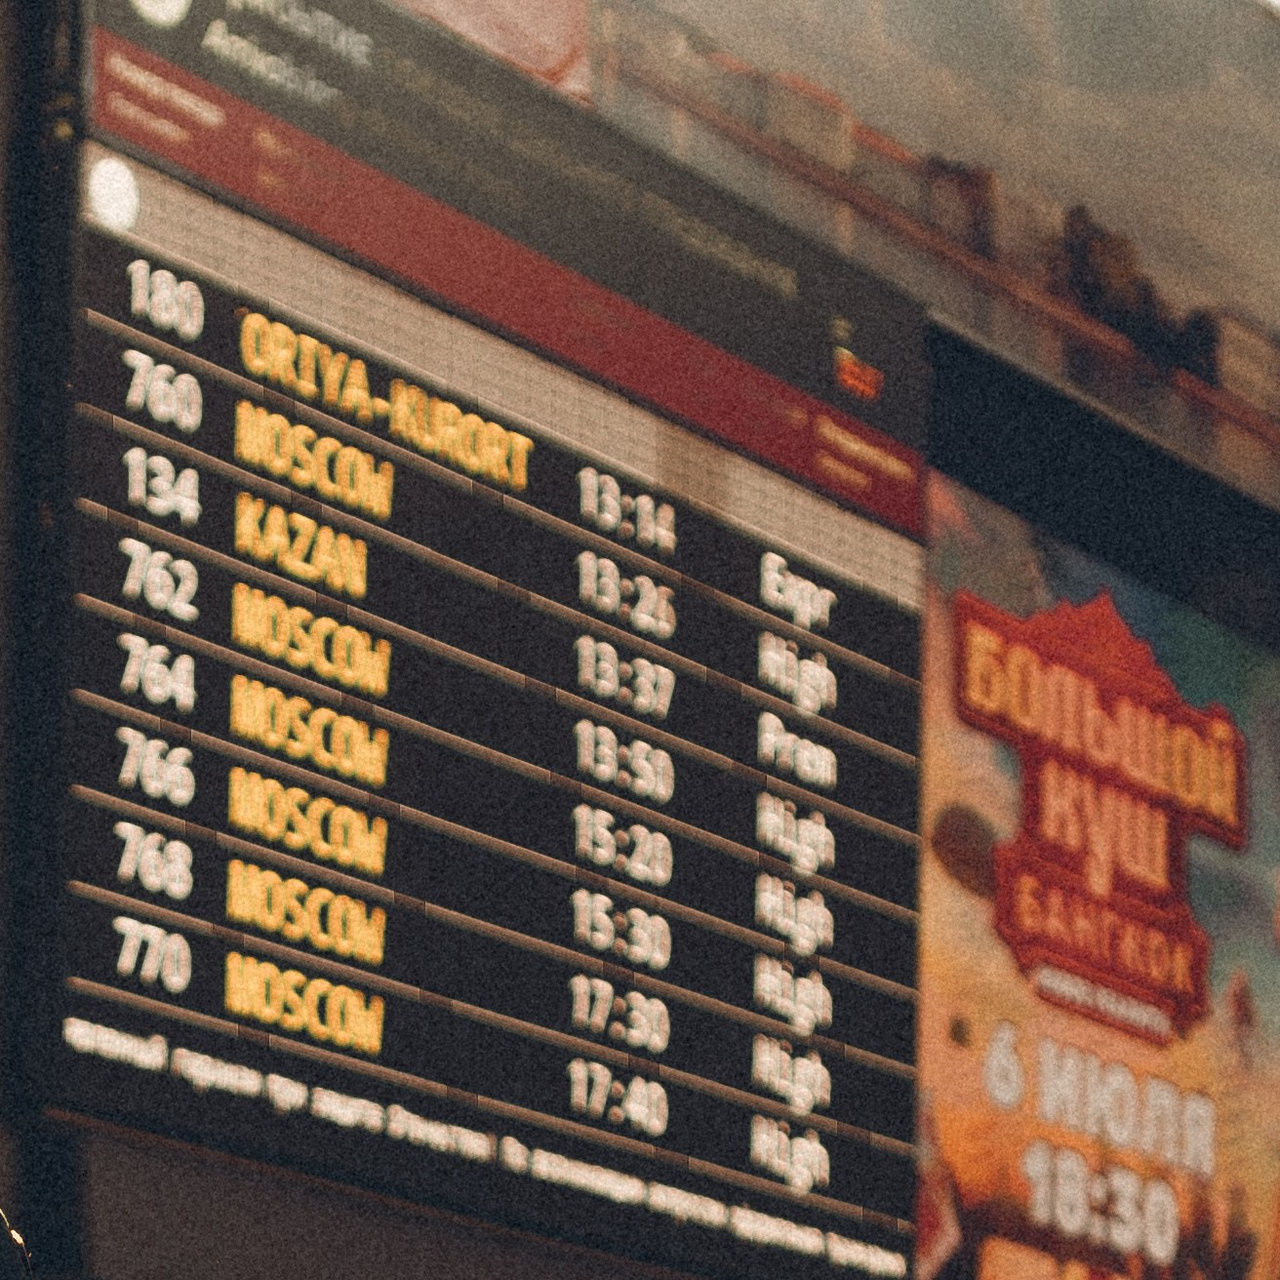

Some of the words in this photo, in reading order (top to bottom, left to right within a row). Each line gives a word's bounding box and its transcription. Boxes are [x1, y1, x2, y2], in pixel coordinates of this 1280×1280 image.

[127, 259, 205, 341] 180
[122, 349, 203, 433] 760
[234, 401, 394, 519] MOSCOW
[124, 447, 201, 524] 134
[234, 493, 367, 598] KAZAN
[118, 537, 200, 621] 762
[231, 583, 391, 694] MOSCOW
[117, 633, 196, 711] 764
[229, 675, 389, 785] MOSCOW
[572, 803, 673, 885] 15:20
[964, 620, 1239, 828] БОЛЬШОЙ
[116, 727, 195, 806] 766
[228, 767, 387, 873] MOSCOW
[571, 889, 671, 970] 15:30
[1039, 758, 1171, 896] КУШ
[114, 821, 193, 899] 768
[226, 859, 386, 963] MOSCOW
[569, 974, 670, 1054] 17:30
[113, 916, 192, 993] 770
[225, 951, 384, 1054] MOSCOW
[568, 1058, 669, 1137] 17:40
[982, 1020, 1024, 1109] 6
[1038, 1037, 1216, 1176] ИЮЛЯ
[1022, 1138, 1180, 1266] 18:30
